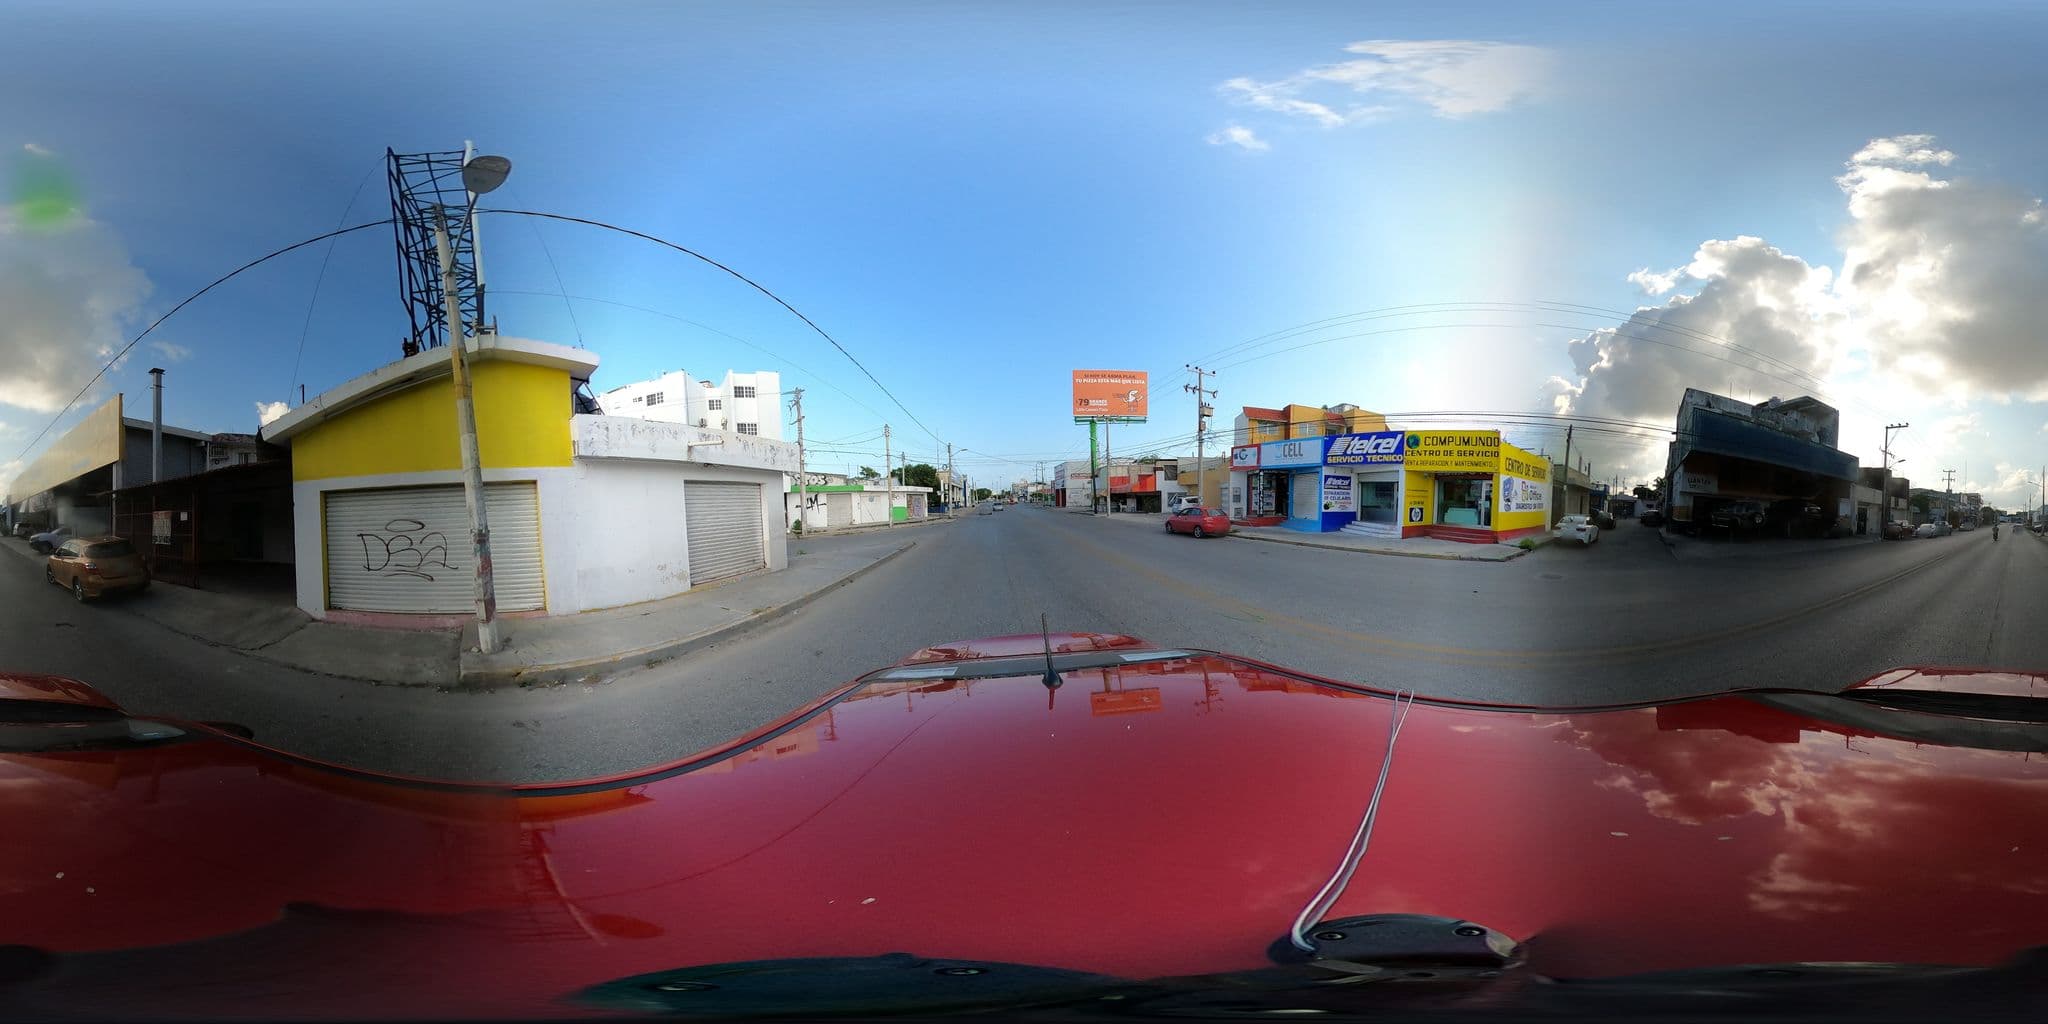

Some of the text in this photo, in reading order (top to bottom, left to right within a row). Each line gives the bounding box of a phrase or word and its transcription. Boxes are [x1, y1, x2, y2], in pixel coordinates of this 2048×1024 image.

[1346, 434, 1403, 454] telcel
[1424, 436, 1500, 447] COMPUMUNDO
[1282, 442, 1304, 458] CELL
[1405, 449, 1500, 458] CENTRO DE SERVICIO
[1327, 454, 1404, 464] SERVICIO TECNICO
[1505, 457, 1525, 475] CENTRO
